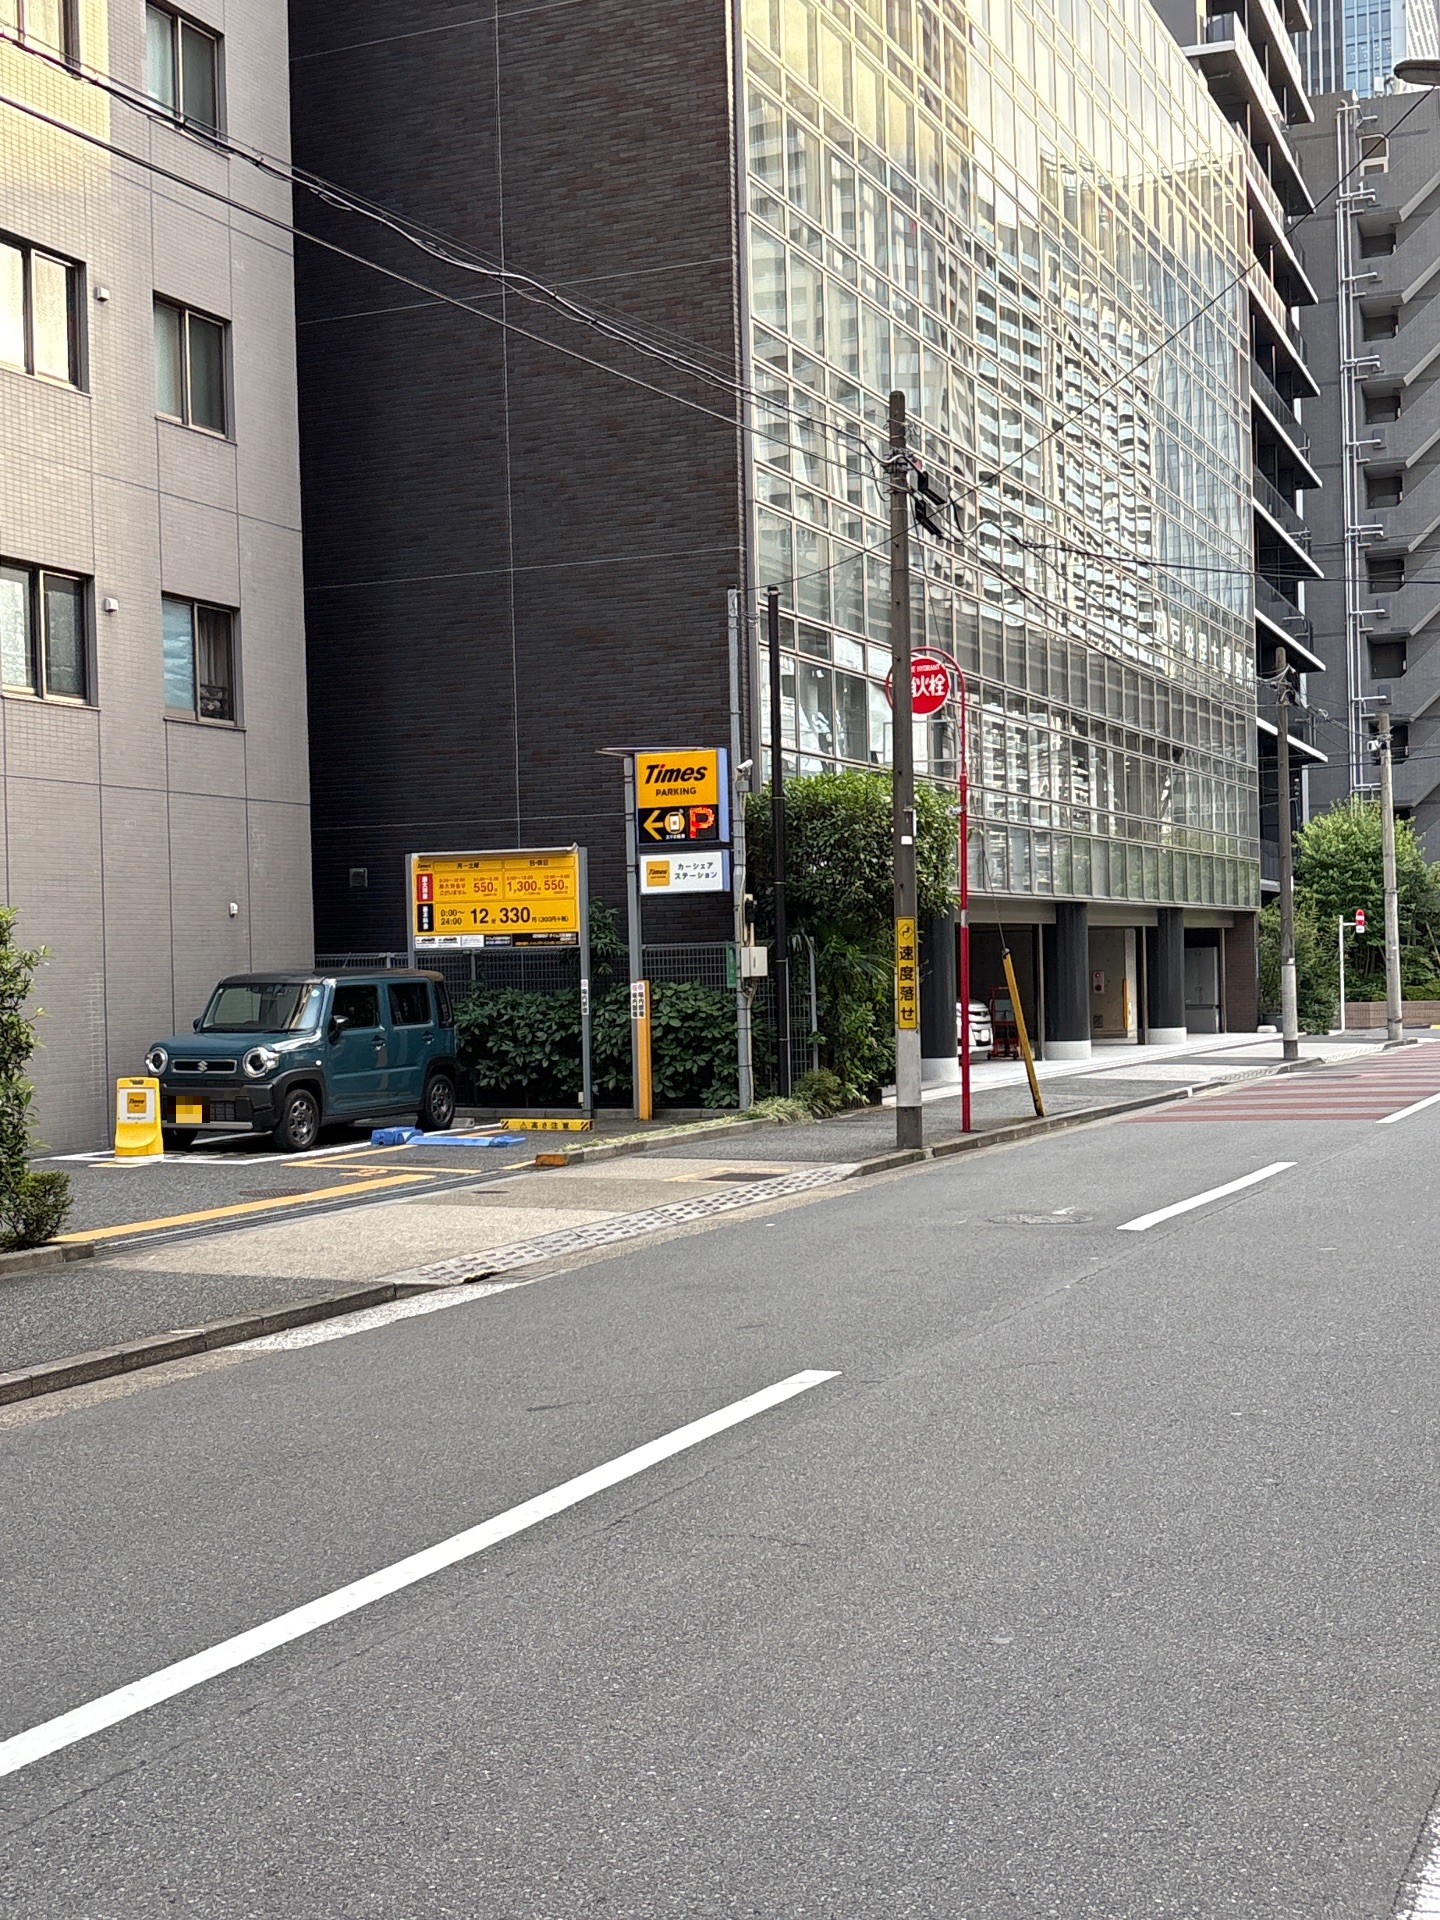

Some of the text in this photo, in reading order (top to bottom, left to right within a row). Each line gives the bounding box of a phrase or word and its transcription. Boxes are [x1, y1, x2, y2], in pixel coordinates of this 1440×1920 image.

[645, 763, 708, 785] Times
[655, 786, 697, 797] PARKING
[678, 862, 714, 871] カーシェア
[648, 868, 668, 876] Times
[674, 871, 718, 881] ステーション
[440, 916, 463, 926] 24:00
[899, 945, 914, 1021] 速度落せ
